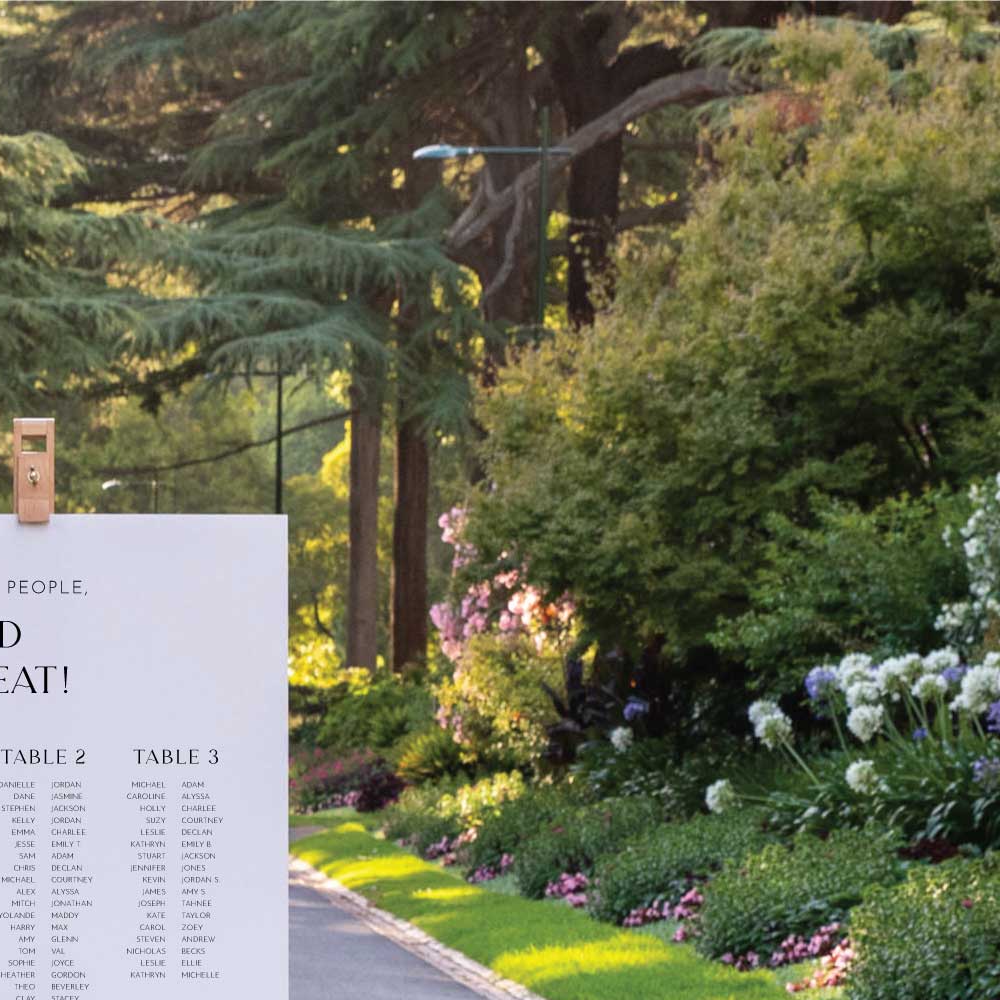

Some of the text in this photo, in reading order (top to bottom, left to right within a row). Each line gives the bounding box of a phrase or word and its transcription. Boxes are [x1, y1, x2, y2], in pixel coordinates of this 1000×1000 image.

[7, 579, 88, 597] PEOPLE,
[0, 748, 86, 766] TABLE 2
[132, 748, 219, 766] TABLE 3
[51, 779, 82, 790] JORDAN
[131, 780, 167, 790] MICHAEL
[181, 780, 205, 789] ADAM
[13, 791, 36, 800] DANE
[126, 792, 166, 800] CAROLINE
[181, 792, 211, 800] ALYSSA
[1, 804, 36, 813] STEPHEN
[50, 804, 86, 813] JACKSON
[139, 804, 166, 813] HOLLY
[181, 804, 217, 813] CHARLEE
[11, 816, 36, 825] KELLY
[50, 815, 82, 825] JORDAN
[145, 816, 166, 824] SUZY
[181, 816, 224, 824] COURTNEY
[11, 828, 36, 837] EMMA
[50, 828, 87, 837] CHARLEE
[140, 828, 166, 837] LESLIE
[181, 828, 213, 837] DECLAN
[13, 840, 36, 849] JESSE
[51, 840, 74, 848] EMILY
[130, 840, 166, 848] KATHRYN
[181, 840, 205, 849] EMILY
[18, 851, 36, 860] SAM
[51, 852, 75, 860] ADAM
[137, 852, 167, 861] STUART
[181, 852, 216, 861] JACKSON
[13, 863, 36, 872] CHRIS
[51, 864, 83, 873] DECLAN
[130, 864, 168, 873] JENNIFER
[181, 864, 206, 873] JONES
[1, 875, 36, 884] MICHAEL
[142, 875, 166, 884] KEVIN
[181, 875, 213, 886] JORDAN
[16, 887, 36, 896] ALEX
[50, 888, 80, 896] ALYSSA
[141, 887, 168, 896] JAMES
[181, 888, 200, 896] AMY
[11, 899, 36, 908] MITCH
[50, 899, 93, 908] JONATHAN
[137, 899, 166, 908] JOSEPH
[181, 898, 213, 908] TAHNEE
[51, 911, 80, 919] MADDY
[145, 911, 167, 919] KATE
[181, 911, 211, 920] TAYLOR
[10, 923, 36, 932] HARRY
[51, 923, 69, 932] MAX
[139, 923, 166, 932] CAROL
[180, 923, 204, 932] ZOEY
[18, 935, 36, 943] AMY
[50, 935, 80, 944] GLENN
[135, 935, 166, 943] STEVEN
[181, 935, 216, 945] ANDREW
[17, 947, 36, 956] TOM
[51, 947, 66, 955] VAL
[126, 946, 167, 956] NICHOLAS
[181, 947, 206, 955] BECKS
[7, 959, 36, 968] SOPHIE
[51, 959, 75, 968] JOYCE
[140, 959, 167, 967] LESLIE
[181, 959, 203, 967] ELLIE
[0, 971, 36, 980] HEATHER
[50, 971, 86, 980] GORDON
[130, 970, 166, 979] KATHRYN
[181, 970, 220, 980] MICHELLE
[14, 983, 36, 991] THEO
[51, 983, 90, 991] BEVERLEY
